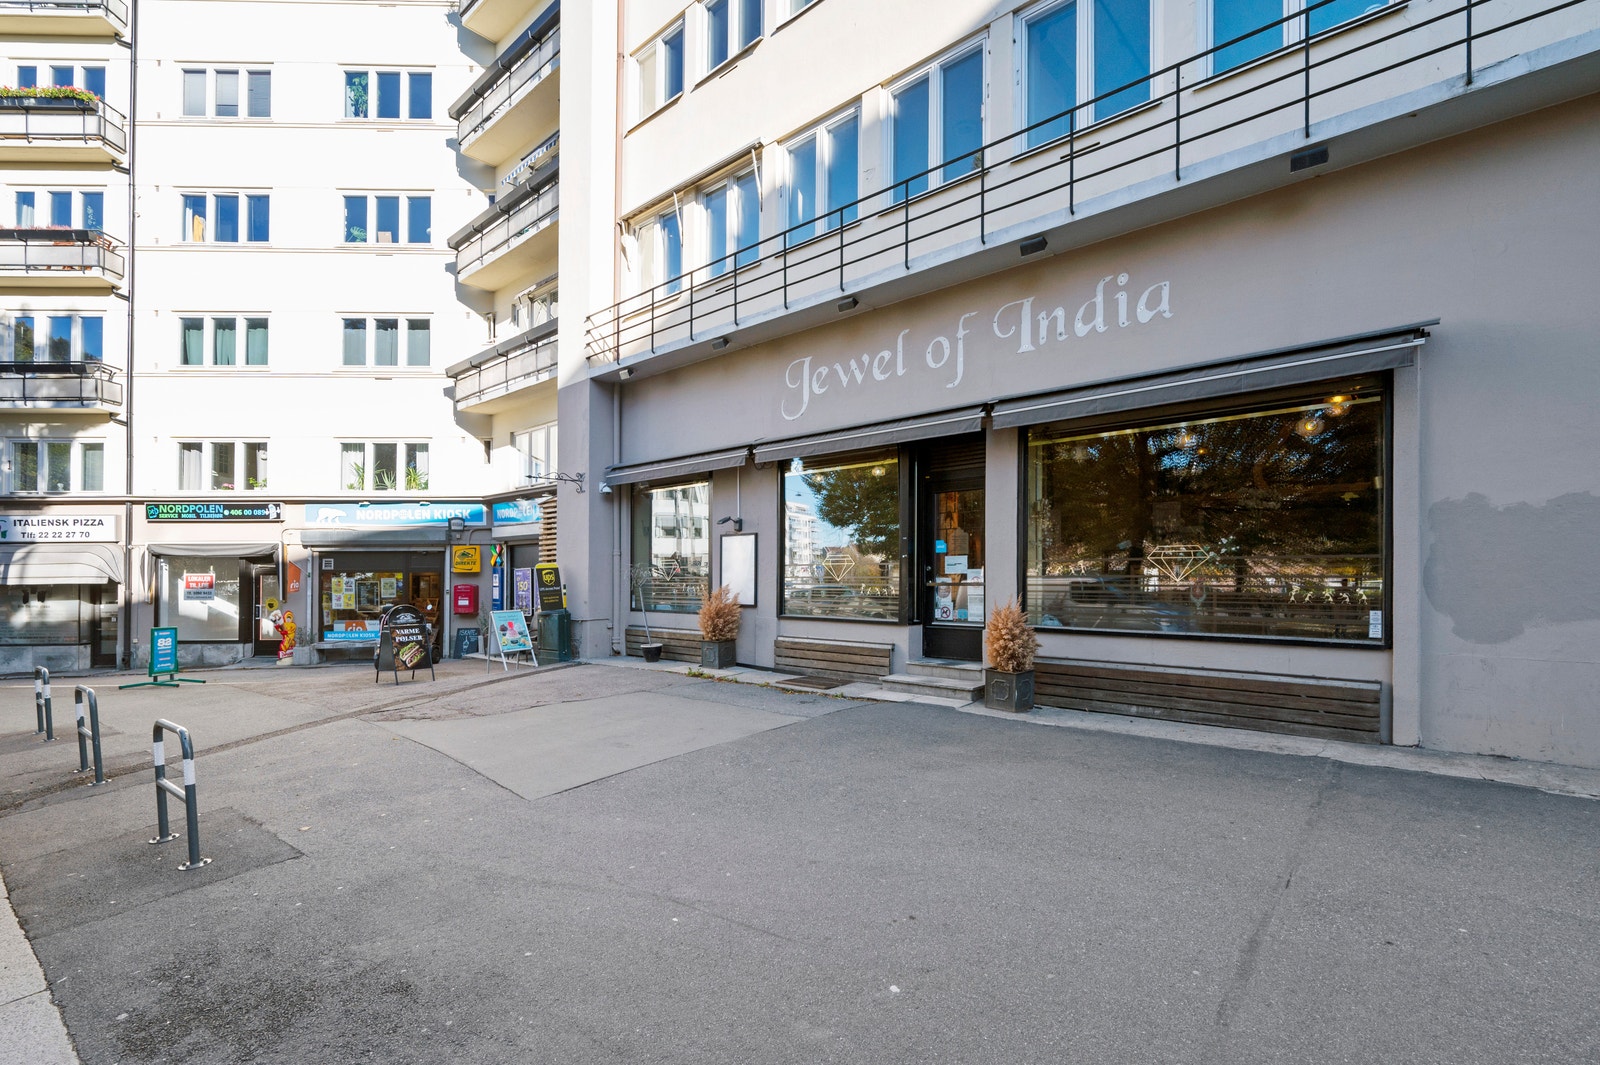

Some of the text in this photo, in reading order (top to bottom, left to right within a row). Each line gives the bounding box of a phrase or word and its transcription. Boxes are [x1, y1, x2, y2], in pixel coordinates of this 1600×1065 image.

[781, 272, 1174, 421] Jewel of India
[159, 504, 223, 513] NORDPOLEN
[434, 508, 471, 519] KIOSK
[13, 519, 69, 527] ITALIENSK
[290, 580, 300, 589] rio
